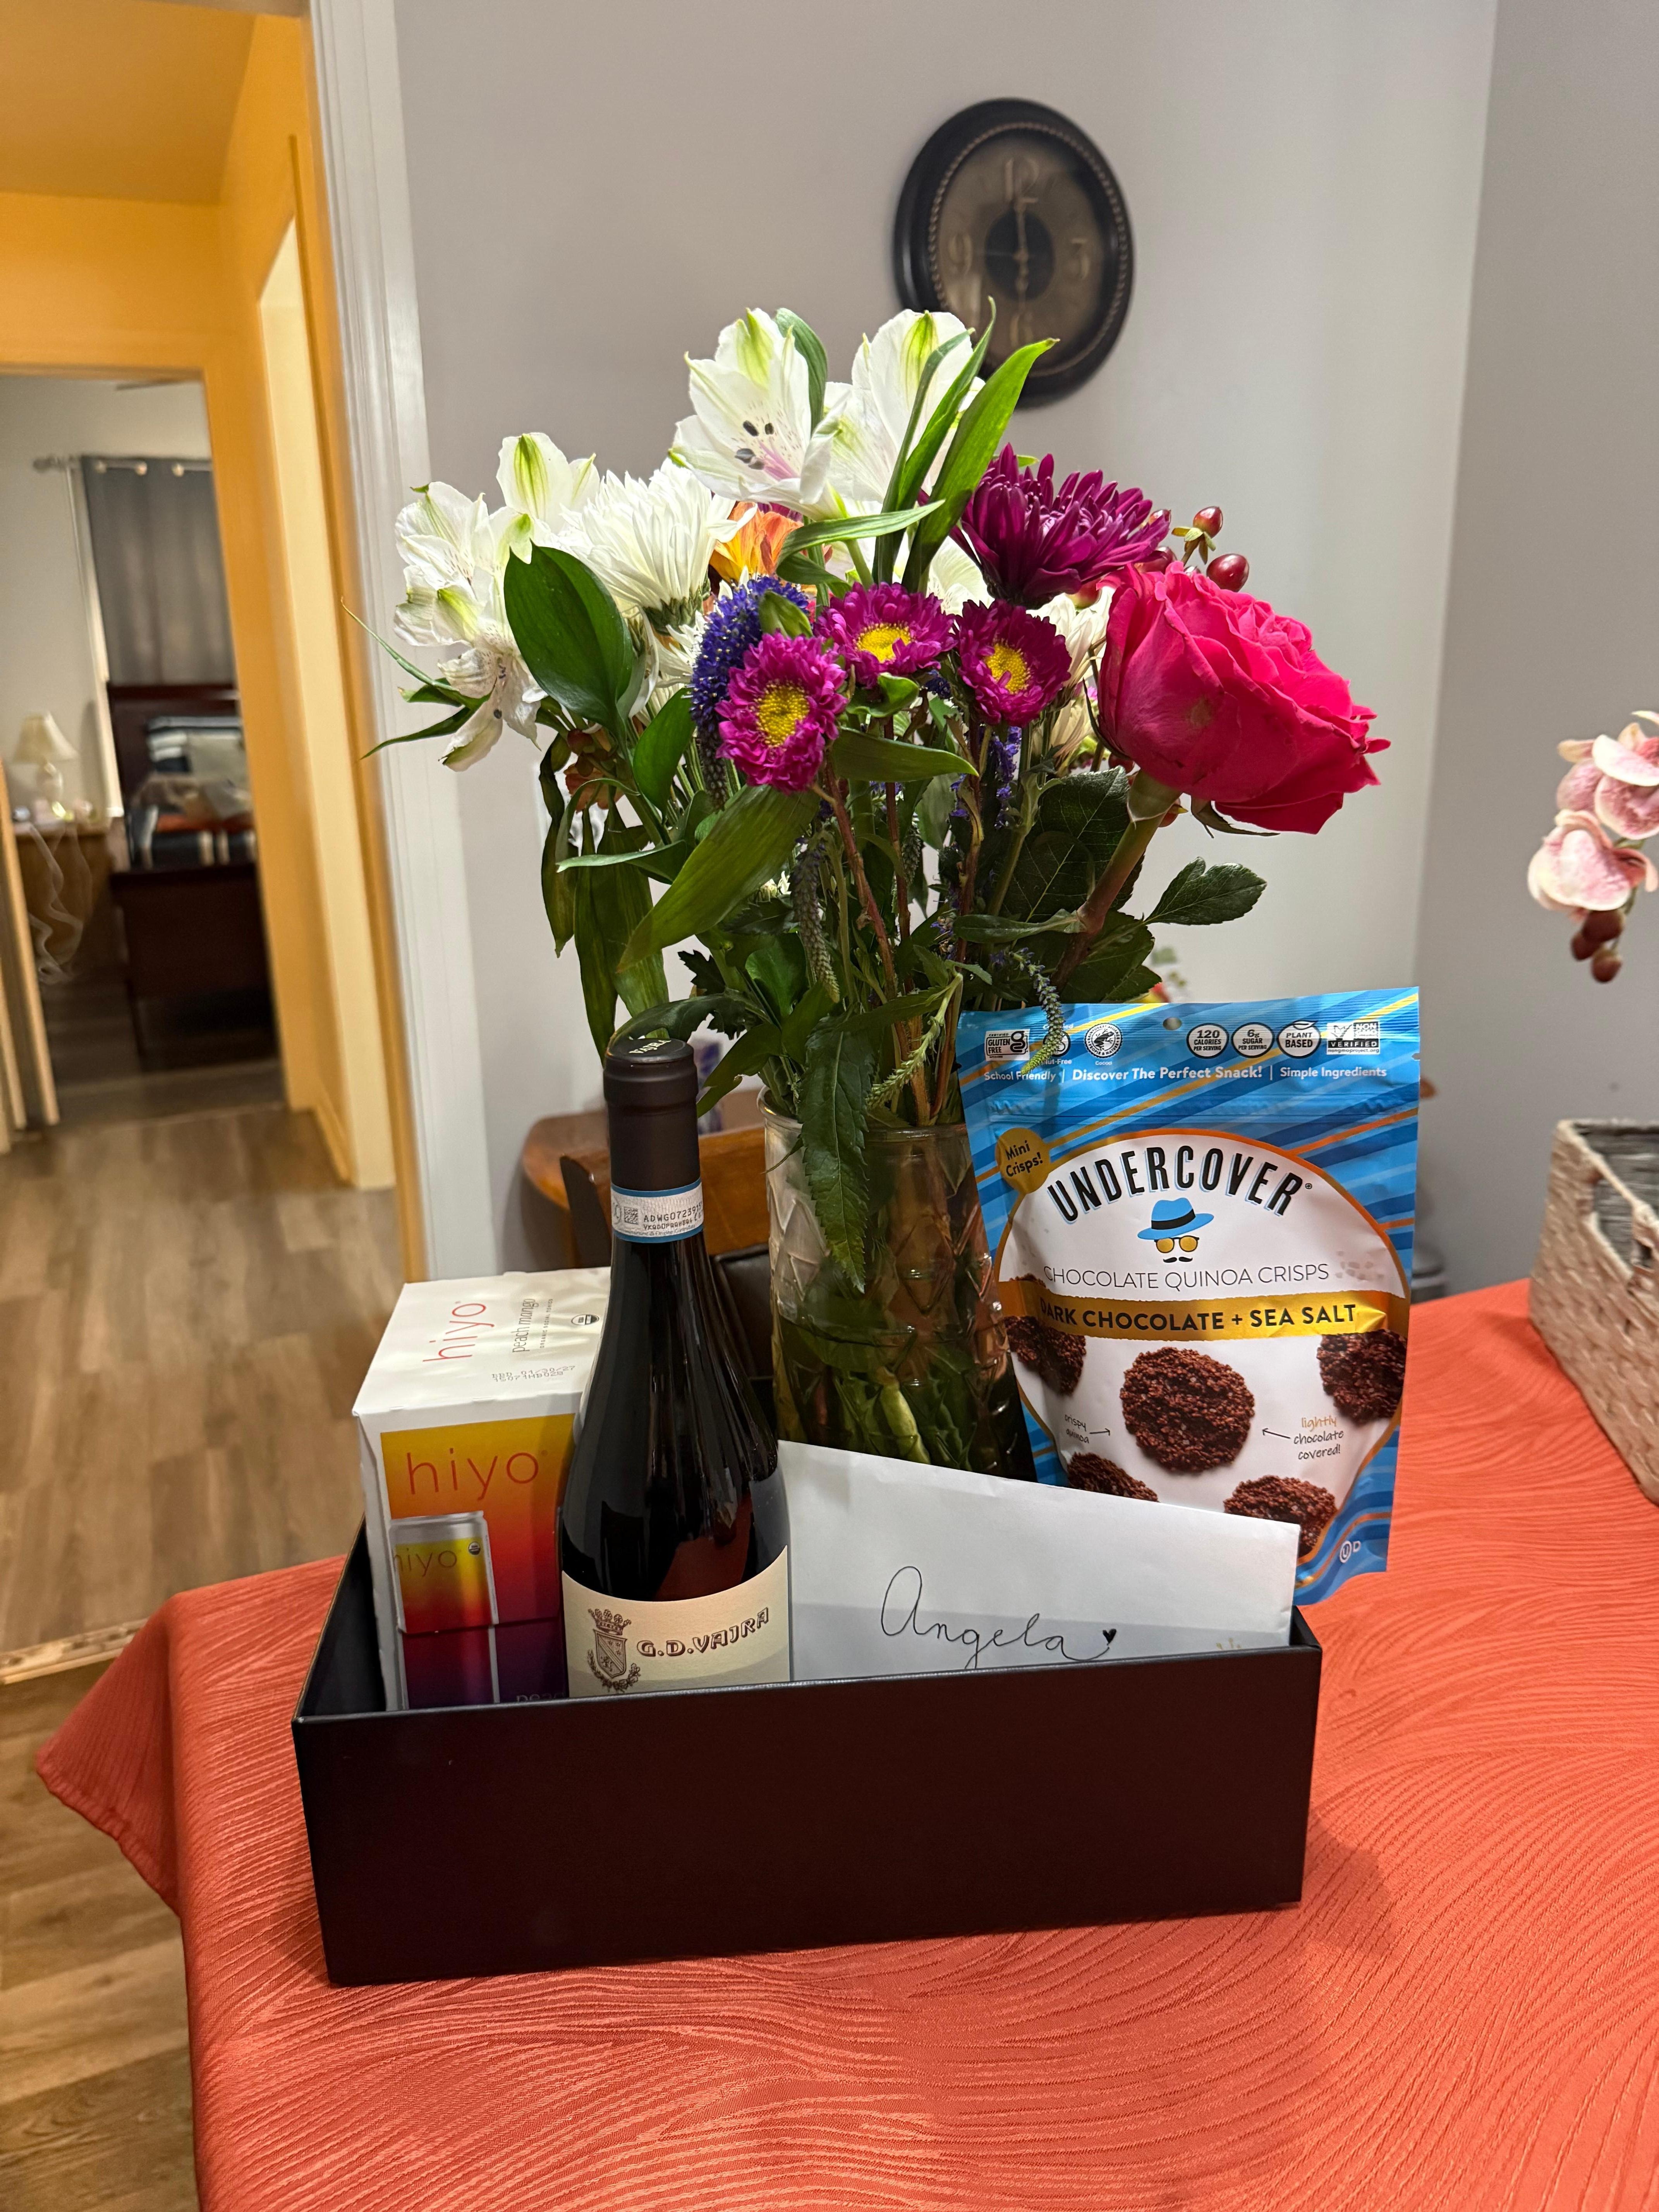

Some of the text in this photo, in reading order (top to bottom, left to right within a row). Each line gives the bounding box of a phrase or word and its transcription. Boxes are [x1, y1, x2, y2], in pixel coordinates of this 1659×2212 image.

[988, 1038, 1011, 1047] GLUTEN
[1197, 1030, 1220, 1039] 120
[1247, 1029, 1260, 1039] 6g
[629, 1040, 672, 1053] VAJRA
[1285, 1039, 1313, 1048] BASED
[984, 1066, 1387, 1082] School Friendly Discover The Perfect Snack! Simple Ingredients
[1005, 1140, 1030, 1161] Mini
[1006, 1151, 1043, 1177] Crisps!
[1046, 1145, 1304, 1223] UNDERCOVER
[1043, 1263, 1329, 1291] CHOCOLATE QUINOA CRISPS
[1039, 1297, 1078, 1326] DARK
[1082, 1310, 1224, 1331] CHOCOLATE
[1250, 1308, 1293, 1327] SEA
[1302, 1304, 1356, 1324] SALT
[422, 1303, 495, 1362] hiyo
[511, 1298, 539, 1353] peach mango
[1065, 1414, 1087, 1432] crispy
[1301, 1415, 1337, 1432] lightly
[1066, 1428, 1089, 1444] quinoa
[1293, 1430, 1344, 1444] chocolate
[1298, 1443, 1341, 1460] covered!
[406, 1447, 539, 1501] hiyo
[392, 1547, 457, 1577] hiyo
[881, 1565, 1110, 1670] Angela
